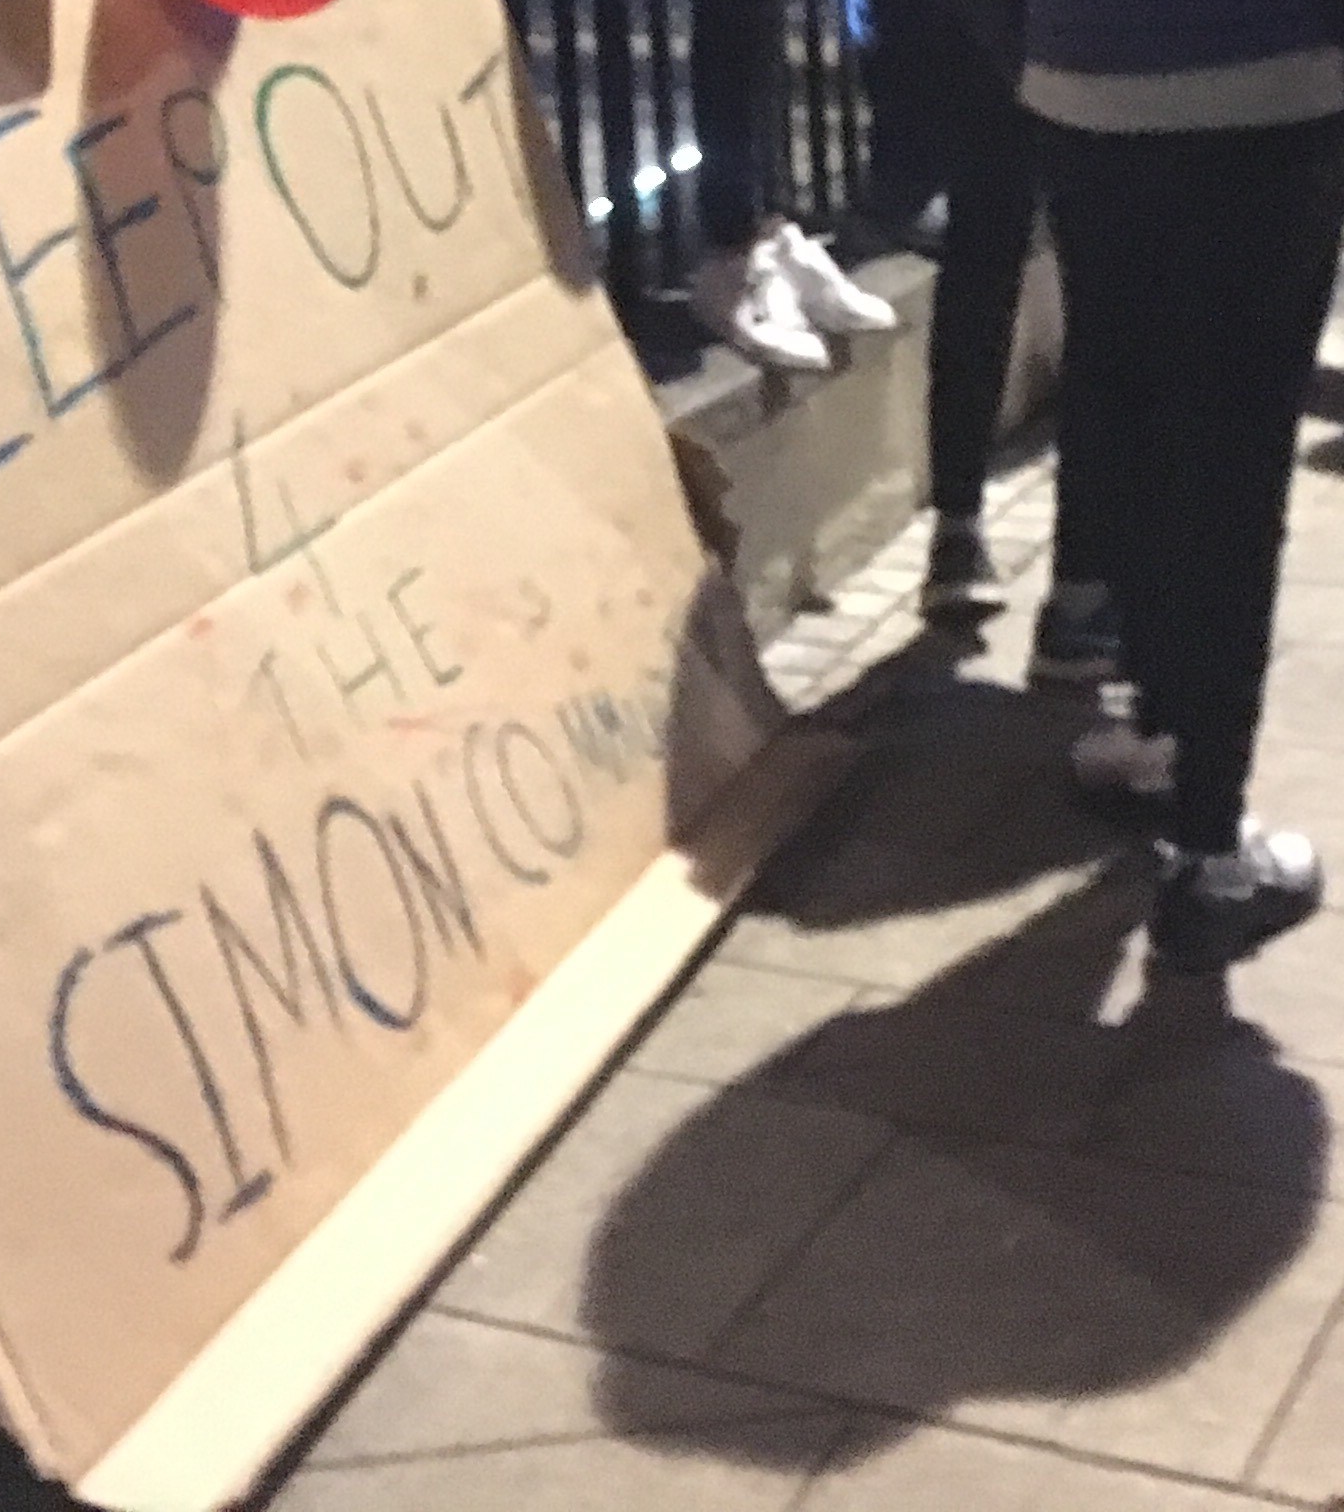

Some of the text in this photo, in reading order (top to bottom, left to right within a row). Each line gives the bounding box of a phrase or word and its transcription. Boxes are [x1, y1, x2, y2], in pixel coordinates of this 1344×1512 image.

[254, 54, 530, 290] OUT
[232, 406, 338, 618] 4
[259, 564, 464, 763] THE
[47, 778, 488, 1266] SIMON
